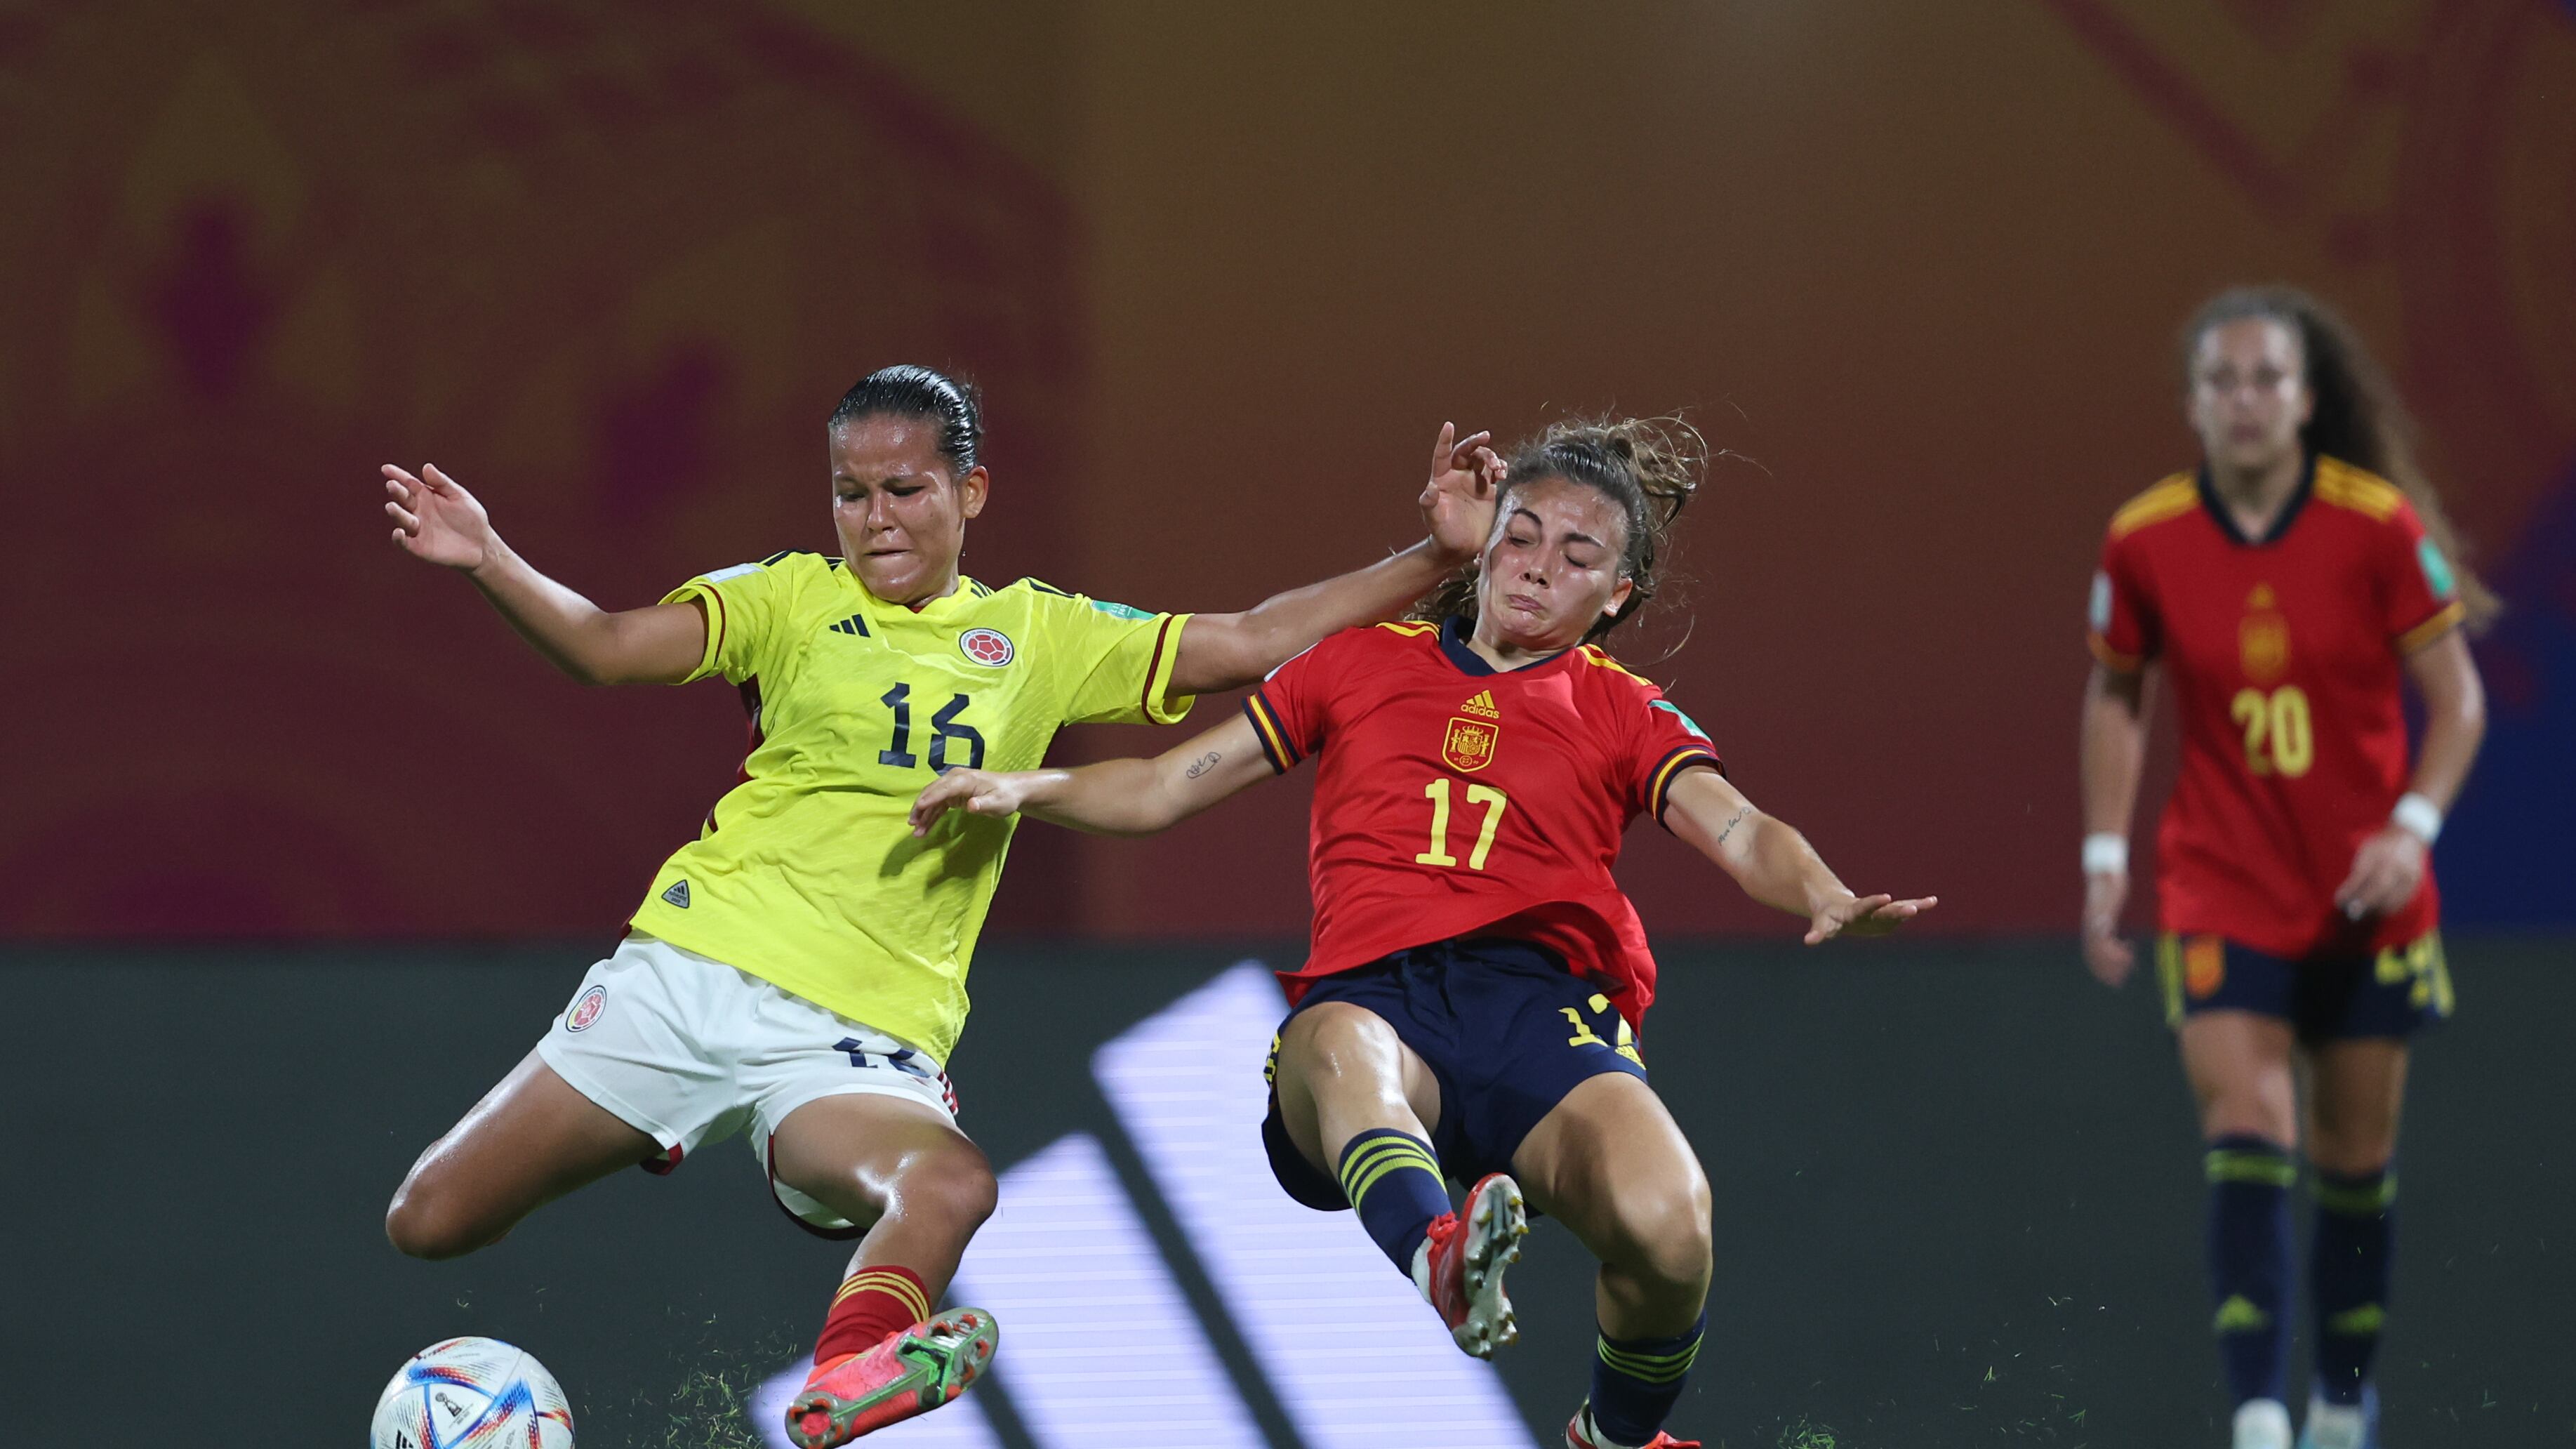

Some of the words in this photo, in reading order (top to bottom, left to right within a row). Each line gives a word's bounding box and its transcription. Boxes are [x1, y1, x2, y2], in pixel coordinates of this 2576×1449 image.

[878, 682, 985, 777] 16
[1461, 704, 1499, 719] adidas
[2231, 684, 2313, 778] 20
[1416, 778, 1508, 871] 17
